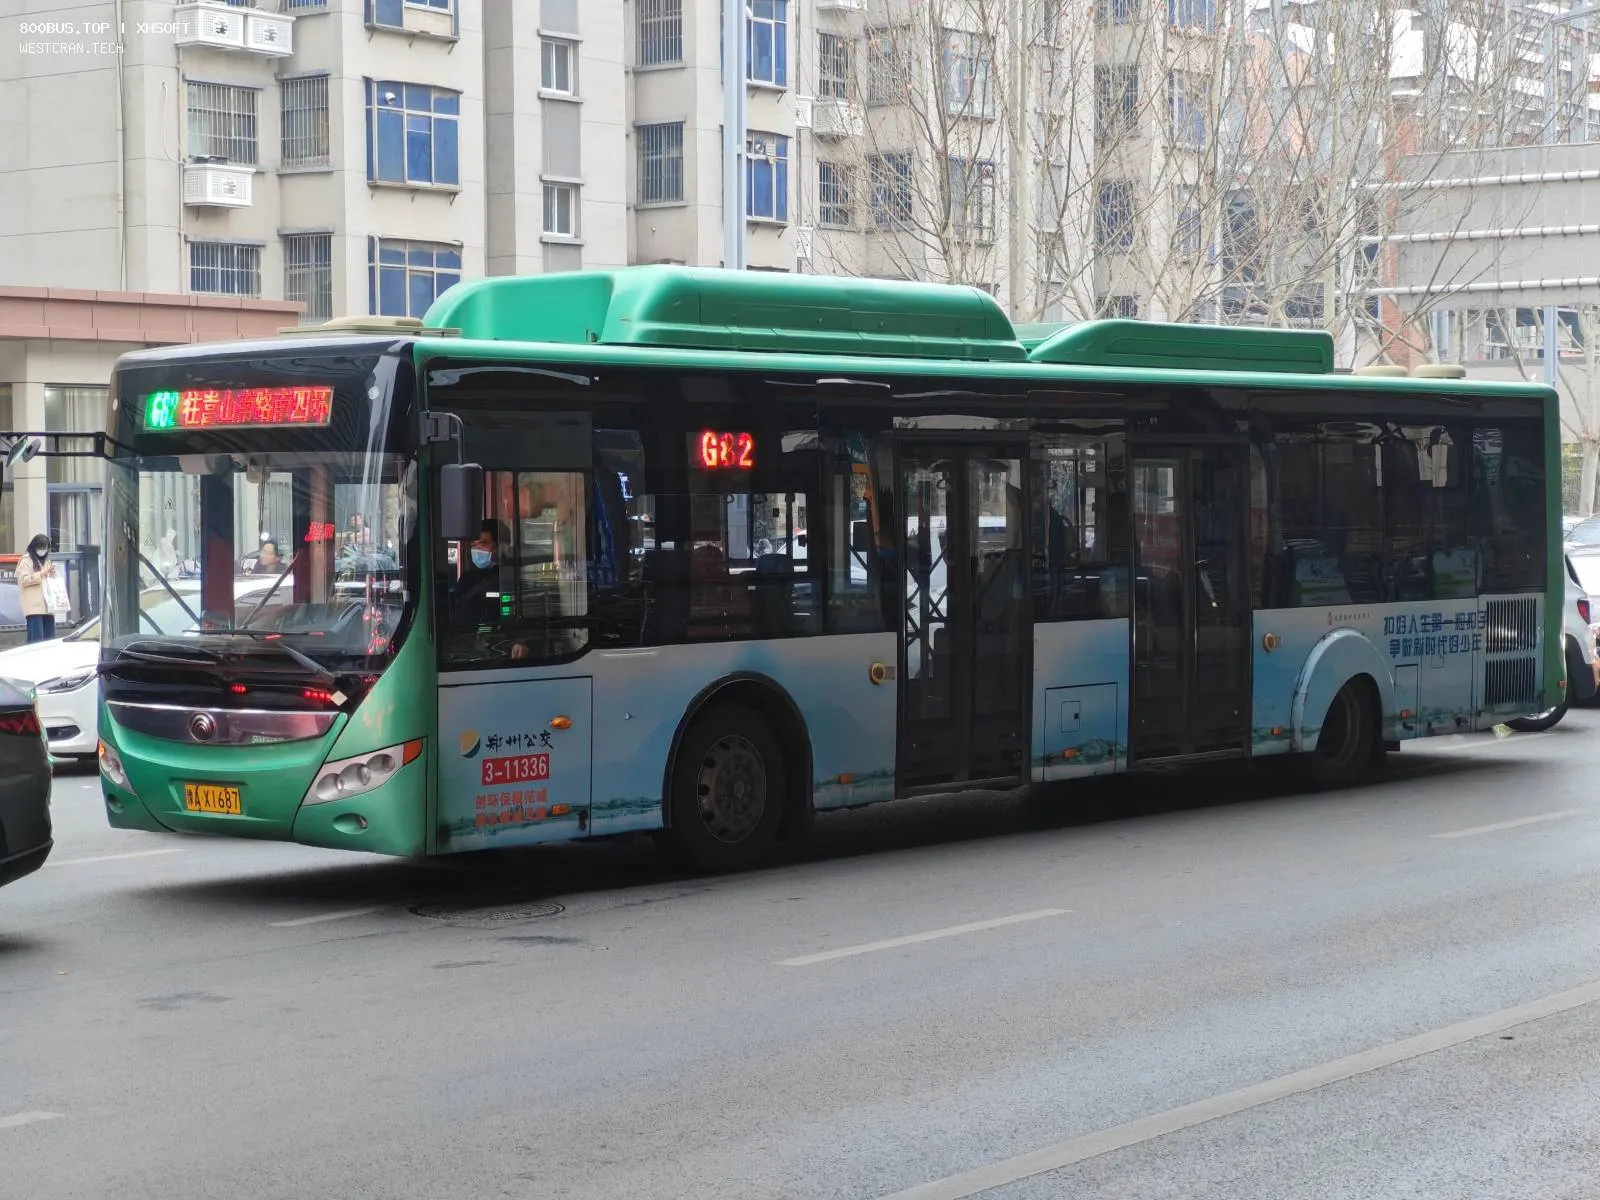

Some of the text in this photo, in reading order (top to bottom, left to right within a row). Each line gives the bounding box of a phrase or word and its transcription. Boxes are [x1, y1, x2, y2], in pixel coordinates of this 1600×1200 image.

[702, 431, 753, 467] G82
[1384, 610, 1488, 636] 扣好人生第一粒扣子
[1390, 633, 1483, 658] 争做新时代好少年
[485, 730, 555, 753] 郑州公交
[485, 757, 548, 783] 3-11336
